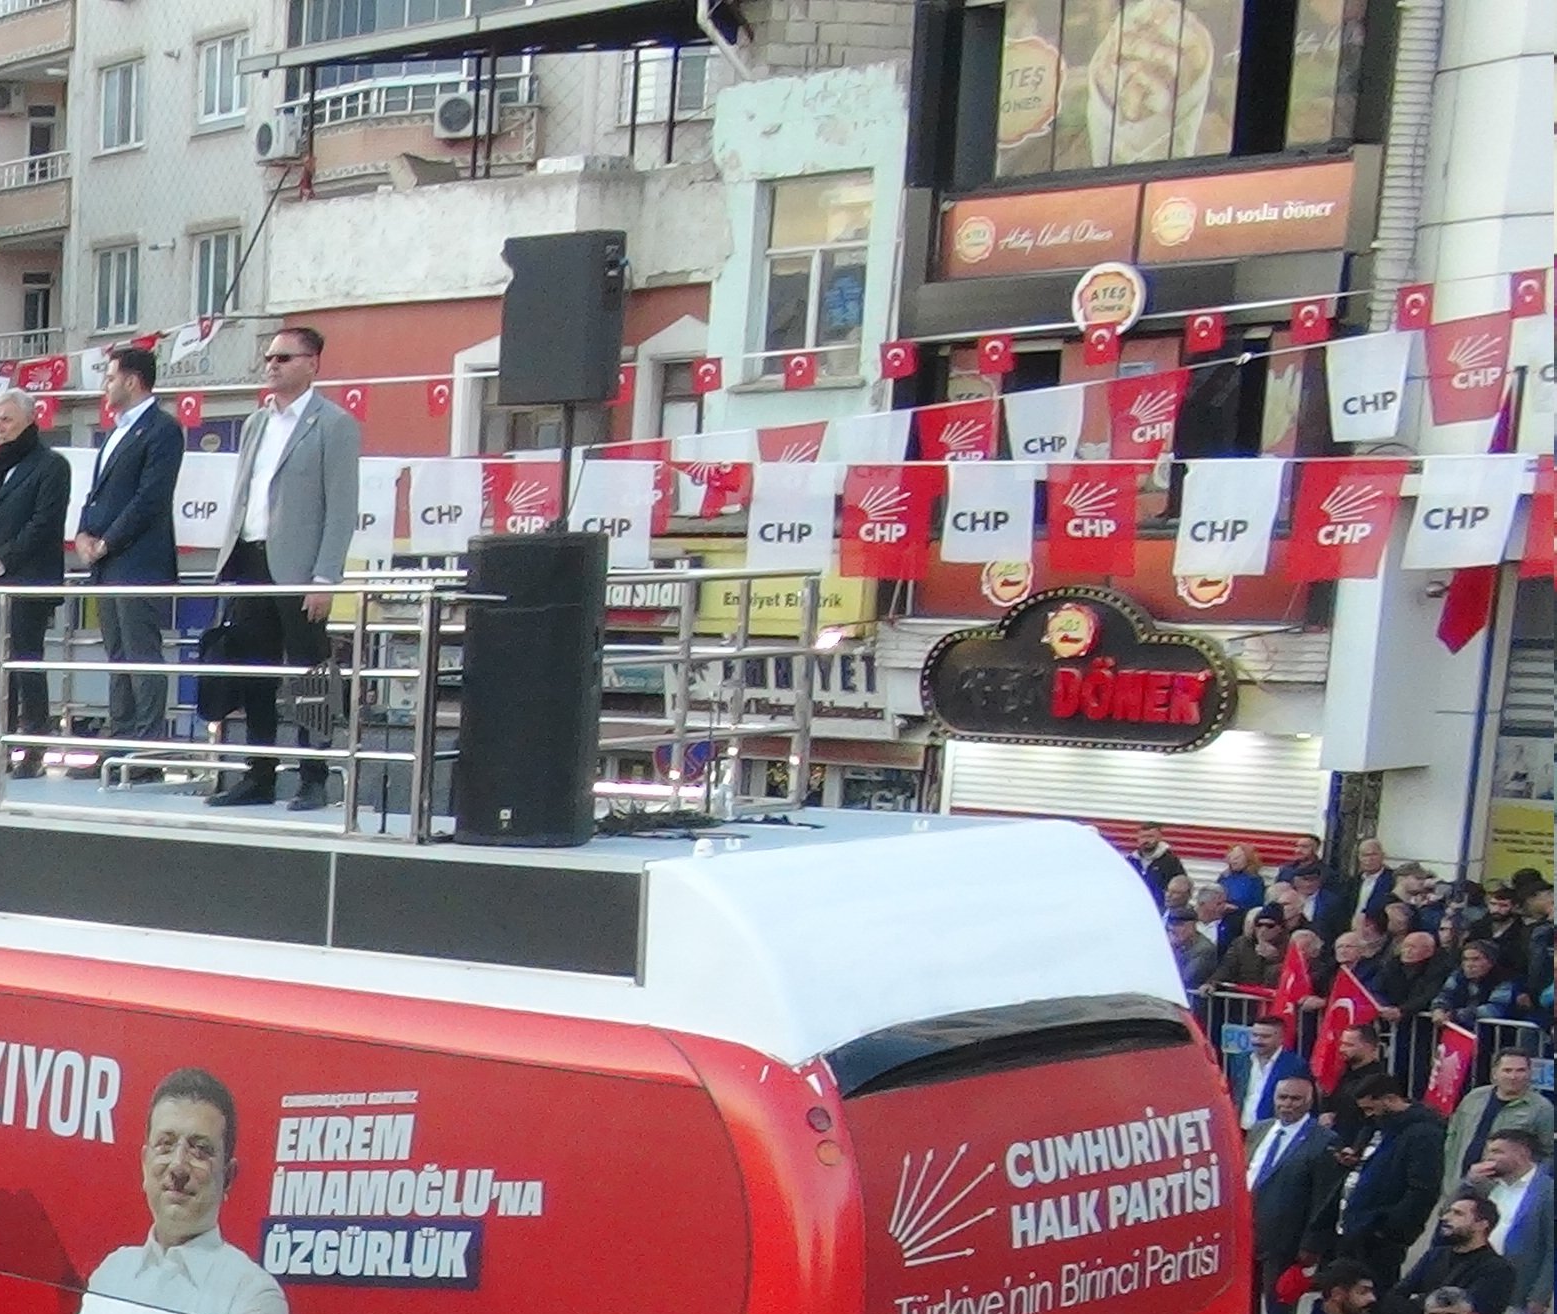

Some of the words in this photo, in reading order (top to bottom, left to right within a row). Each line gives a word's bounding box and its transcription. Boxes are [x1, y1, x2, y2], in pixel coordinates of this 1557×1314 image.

[1006, 66, 1046, 92] TEŞ
[1205, 206, 1232, 226] bol
[1452, 367, 1502, 389] CHP
[1342, 391, 1398, 415] CHP
[1132, 421, 1173, 442] CHP
[1023, 435, 1067, 454] CHP
[182, 501, 218, 520] CHP
[420, 505, 463, 525] CHP
[952, 511, 1009, 532] CHP
[1423, 506, 1490, 530] CHP
[506, 515, 545, 534] CHP
[582, 518, 632, 538] CHP
[758, 521, 813, 544] CHP
[859, 522, 907, 544] CHP
[1066, 518, 1117, 538] CHP
[1190, 520, 1248, 542] CHP
[1318, 523, 1372, 545] CHP
[1050, 656, 1213, 724] DÖNER
[276, 1113, 415, 1162] EKREM
[1005, 1106, 1212, 1190] CUMHURİYET
[269, 1163, 544, 1217] İMAMOĞLU'NA
[1011, 1187, 1103, 1250] HALK
[1108, 1154, 1221, 1231] PARTİSİ
[263, 1223, 472, 1278] ÖZGÜRLÜK
[1060, 1255, 1139, 1310] Birinci
[1145, 1233, 1221, 1287] Partisi
